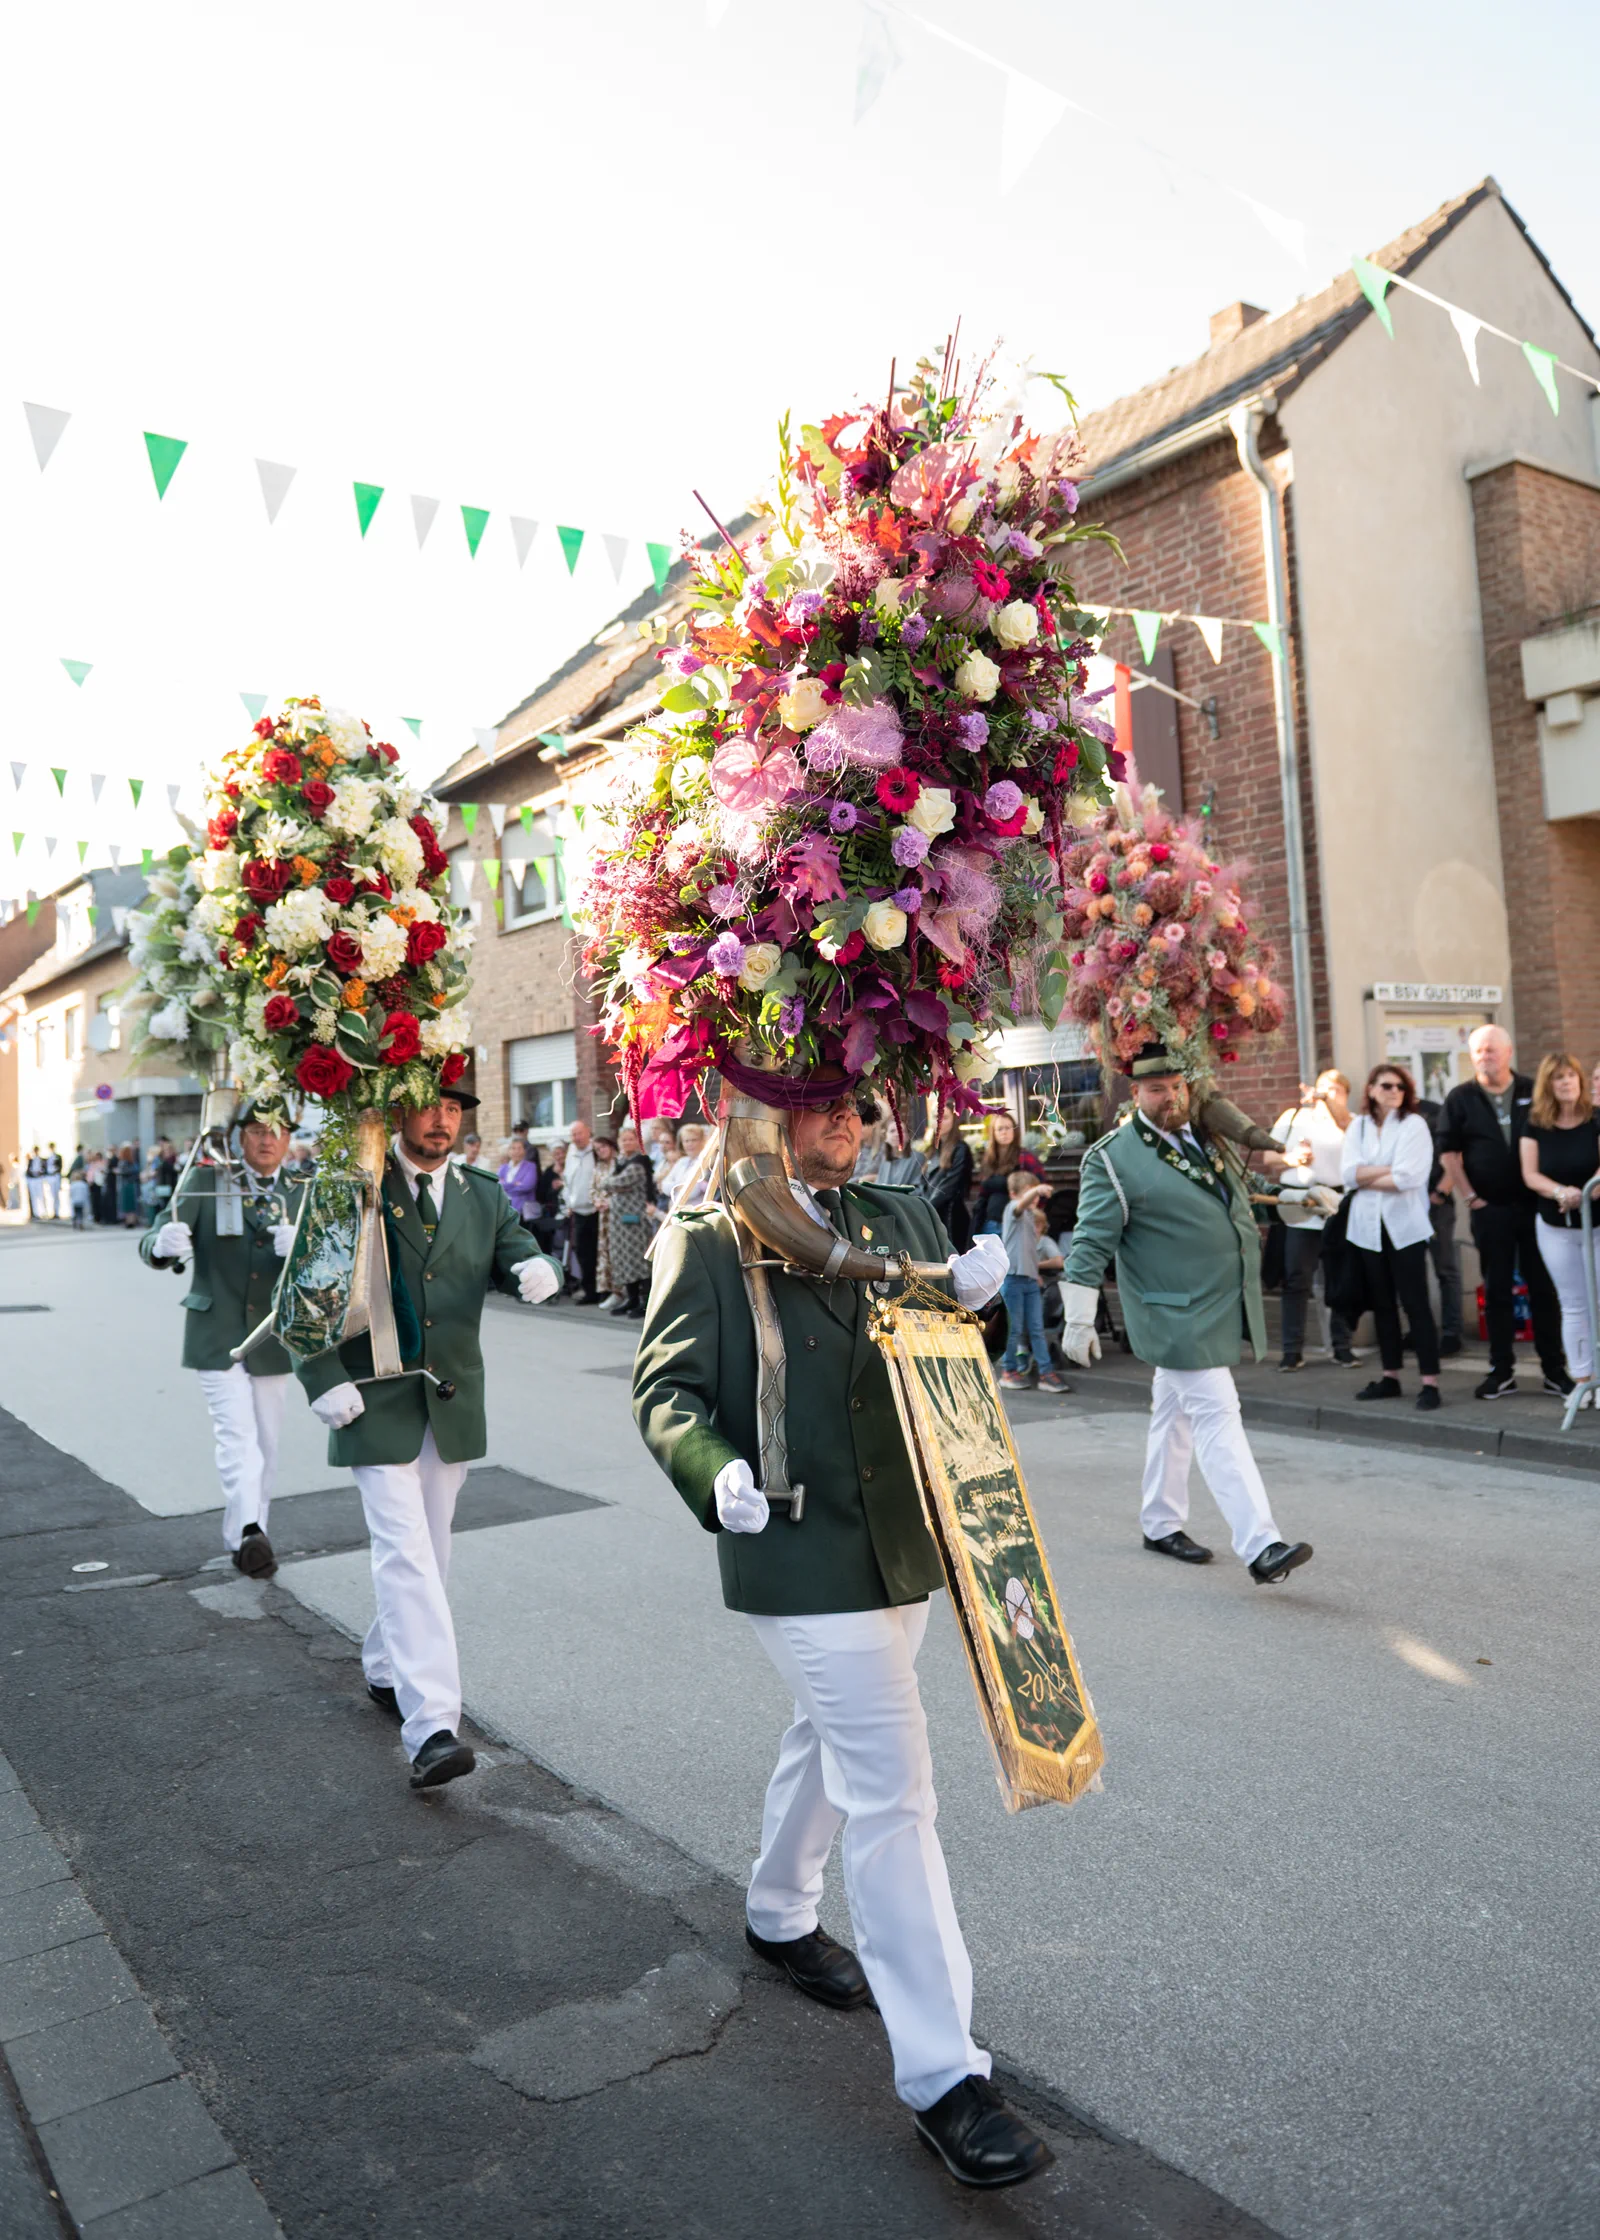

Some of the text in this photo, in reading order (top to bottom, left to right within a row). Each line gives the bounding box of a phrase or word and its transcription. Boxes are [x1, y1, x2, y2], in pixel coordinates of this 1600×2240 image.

[1395, 985, 1482, 1000] BSV GUSTORF
[1017, 1662, 1067, 1703] 2012
